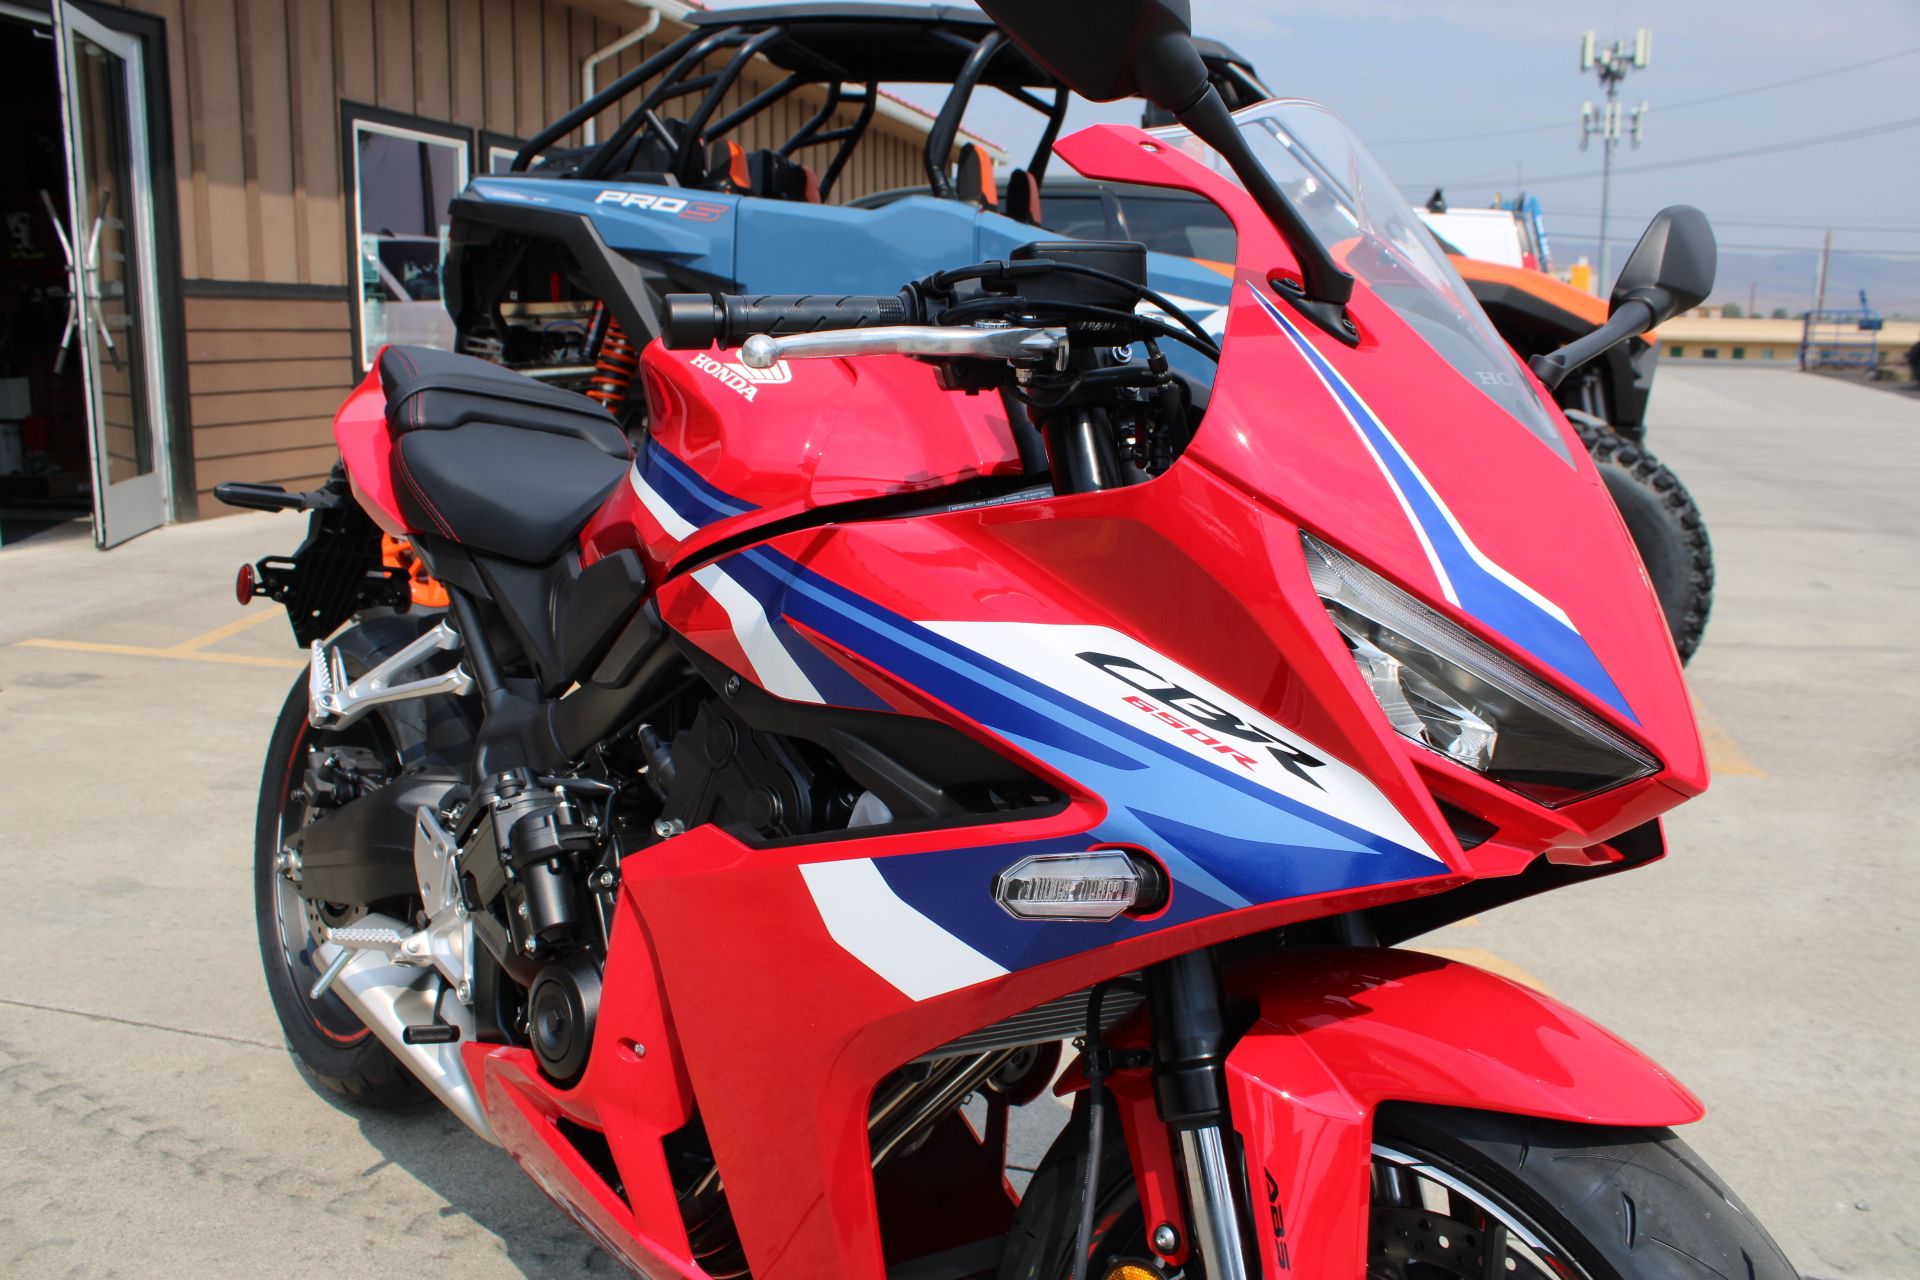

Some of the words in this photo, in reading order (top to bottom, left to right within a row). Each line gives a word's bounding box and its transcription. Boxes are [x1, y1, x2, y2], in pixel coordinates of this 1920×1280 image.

[595, 190, 688, 214] PRO
[690, 352, 759, 403] HONDA
[1075, 651, 1329, 794] CBR
[1121, 695, 1259, 773] 650R
[1263, 1165, 1291, 1272] ABS
